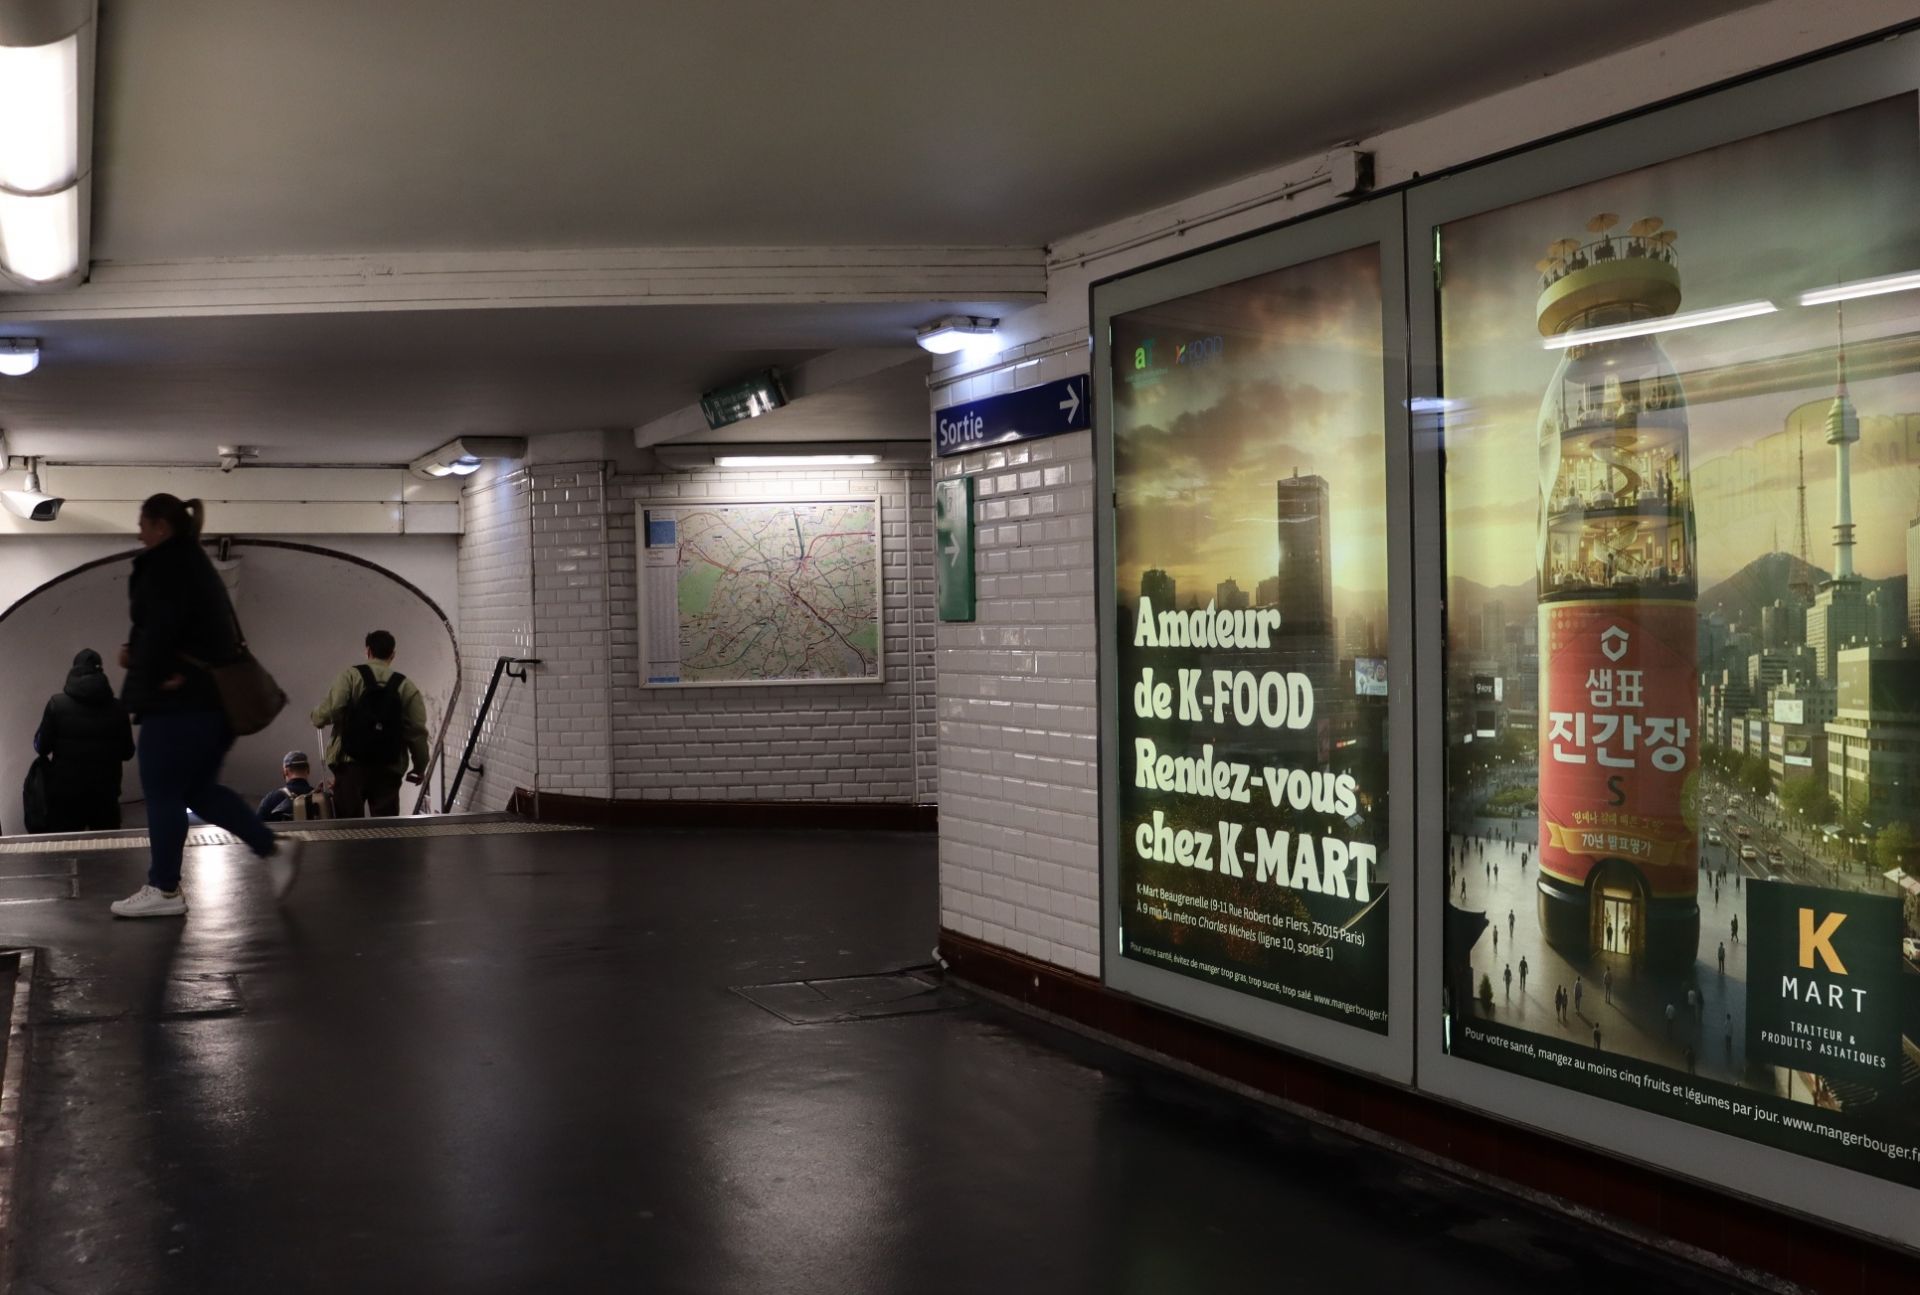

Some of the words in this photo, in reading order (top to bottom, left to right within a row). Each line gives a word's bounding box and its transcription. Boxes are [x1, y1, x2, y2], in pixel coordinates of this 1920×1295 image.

[940, 411, 984, 446] Sortie
[1134, 595, 1281, 648] Amateur
[1134, 668, 1172, 719] de
[1178, 669, 1314, 729] K-FOOD
[1585, 669, 1643, 707] 샘표
[1548, 712, 1690, 772] 진간장
[1135, 738, 1358, 817] Rendez-vous
[1607, 776, 1626, 806] S
[1136, 811, 1213, 871] chez
[1219, 821, 1377, 903] K-MART
[1137, 884, 1159, 898] K-Mart
[1160, 888, 1208, 909] Beaugrenelle
[1210, 899, 1227, 914] (9-11
[1229, 903, 1242, 917] Rue
[1243, 907, 1271, 925] Robert
[1272, 914, 1283, 927] de
[1286, 916, 1310, 935] Flers,
[1312, 922, 1338, 939] 75015
[1340, 927, 1365, 947] Paris)
[1137, 901, 1142, 912] À
[1143, 903, 1148, 914] 9
[1149, 906, 1163, 919] min
[1163, 910, 1172, 921] du
[1174, 912, 1196, 926] métro
[1199, 916, 1227, 933] Charles
[1229, 923, 1256, 941] Michels
[1258, 931, 1280, 948] (ligne
[1282, 937, 1295, 953] 10,
[1298, 943, 1324, 957] sortie
[1325, 947, 1333, 961] 1)
[1799, 908, 1848, 975] K
[1130, 942, 1141, 952] Pour
[1142, 947, 1156, 956] votre
[1157, 951, 1173, 962] santé,
[1174, 954, 1189, 966] évitez
[1190, 959, 1198, 968] de
[1199, 963, 1220, 975] manger
[1221, 968, 1233, 979] trop
[1234, 972, 1248, 984] gras,
[1249, 976, 1261, 988] trop
[1263, 981, 1281, 993] sucré,
[1282, 985, 1296, 997] trop
[1297, 990, 1312, 1000] salé.
[1782, 976, 1866, 1012] MART
[1762, 1031, 1812, 1051] PRODUITS
[1820, 1044, 1885, 1068] ASIATIQUES
[1791, 1021, 1842, 1042] TRAITEUR
[1850, 1036, 1855, 1044] &
[1465, 1027, 1484, 1041] Pour
[1486, 1035, 1509, 1048] votre
[1510, 1042, 1536, 1058] santé,
[1538, 1049, 1572, 1066] mangez
[1574, 1059, 1585, 1069] au
[1588, 1063, 1617, 1078] moins
[1619, 1070, 1641, 1087] cinq
[1644, 1075, 1670, 1093] fruits
[1673, 1086, 1683, 1097] et
[1686, 1087, 1730, 1110] légumes
[1733, 1103, 1752, 1115] par
[1754, 1105, 1779, 1123] jour.
